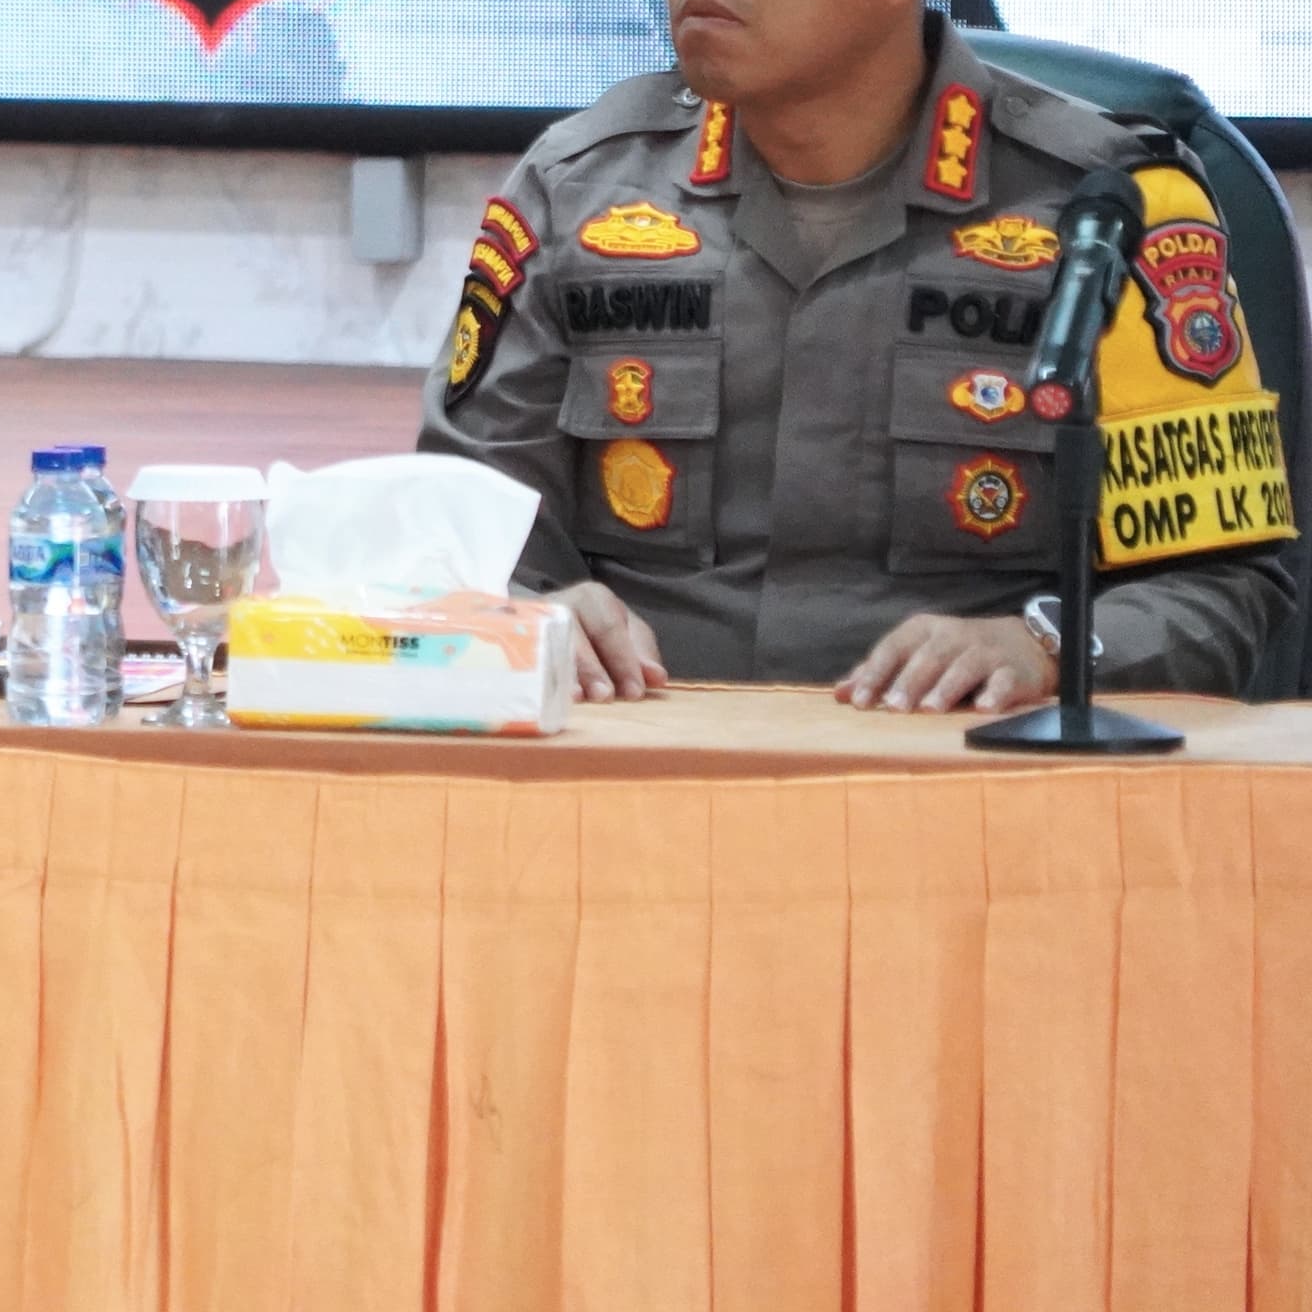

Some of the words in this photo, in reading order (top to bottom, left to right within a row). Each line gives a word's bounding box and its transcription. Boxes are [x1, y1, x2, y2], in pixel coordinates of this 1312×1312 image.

[1143, 233, 1217, 269] POLDA
[1163, 267, 1214, 287] RIAU
[565, 282, 712, 331] RASWIN
[1104, 412, 1226, 493] KASATGAS
[1114, 492, 1198, 549] OMP
[1215, 484, 1254, 532] LK
